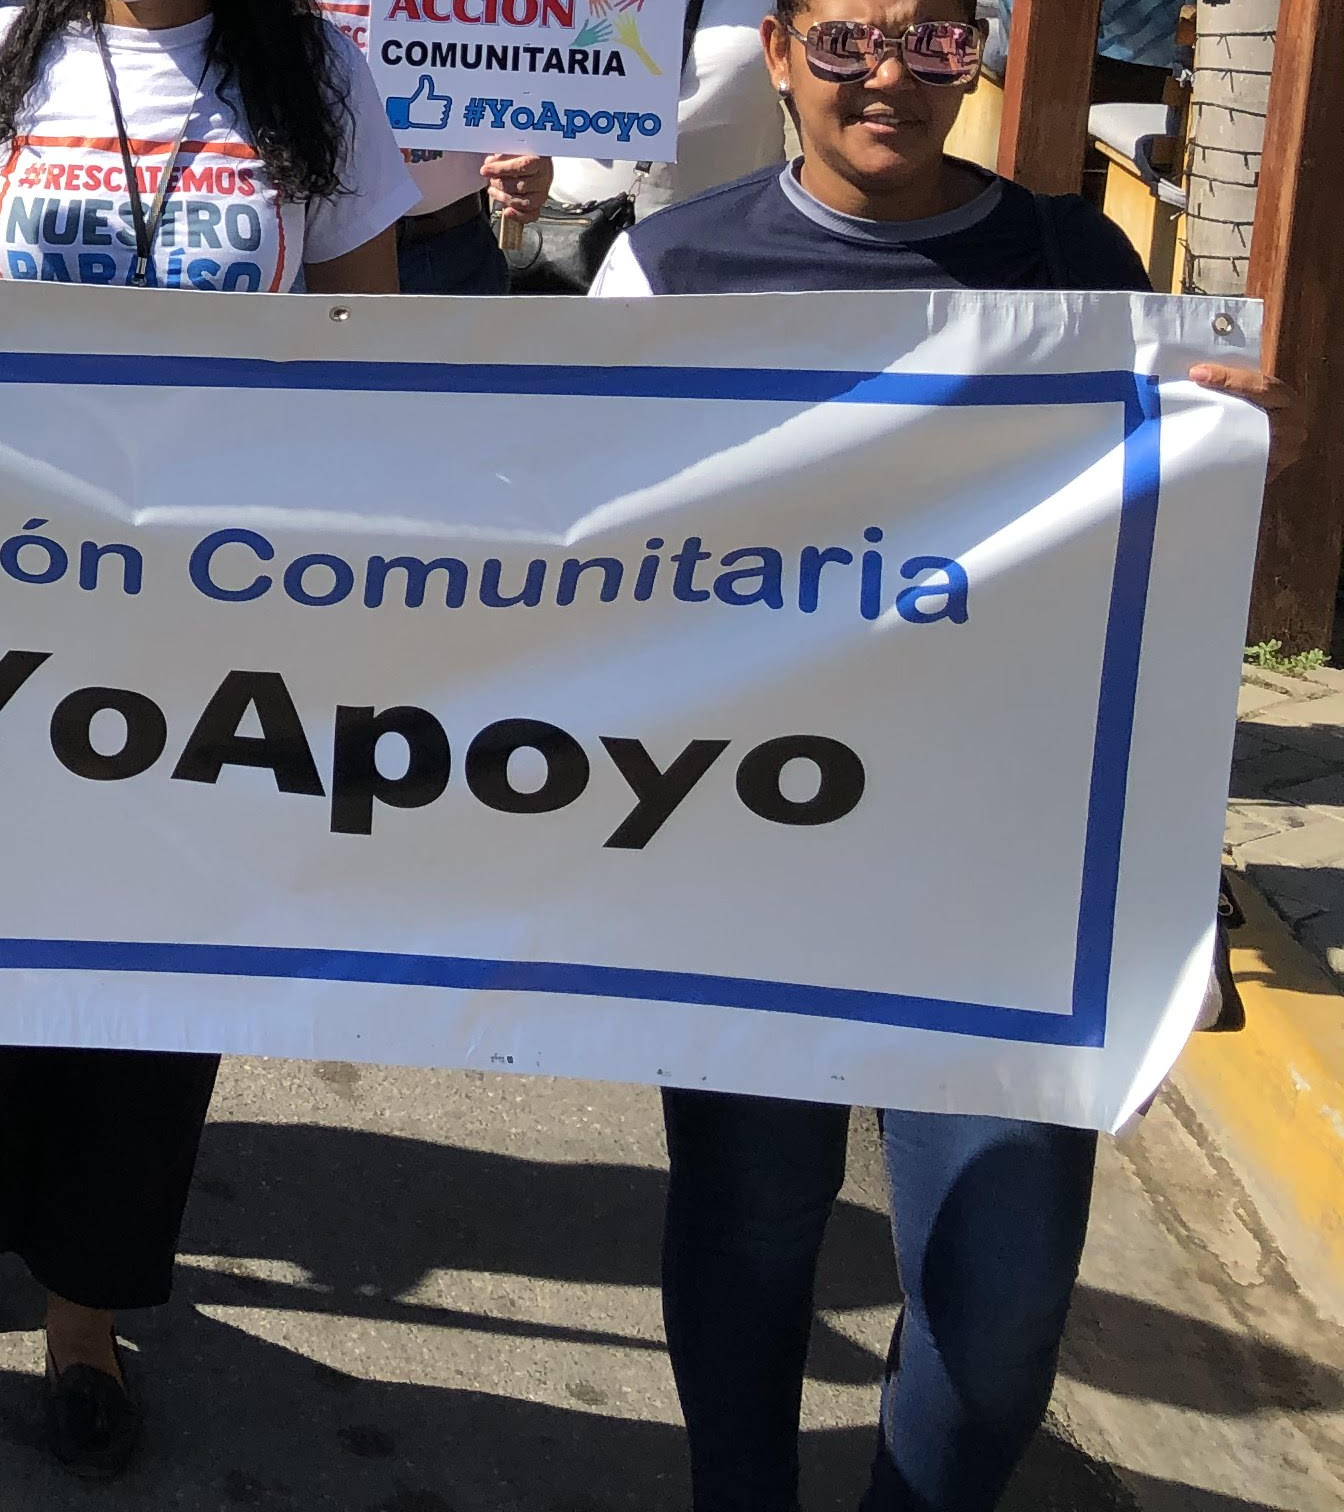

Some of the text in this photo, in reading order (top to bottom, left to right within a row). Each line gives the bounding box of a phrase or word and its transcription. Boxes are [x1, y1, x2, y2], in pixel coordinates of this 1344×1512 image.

[381, 40, 626, 77] COMUNITARIA
[463, 96, 662, 141] #YoApoyo
[18, 163, 255, 196] #RESCATEMOS
[6, 196, 262, 252] NUESTRO
[187, 525, 972, 626] Comunitaria
